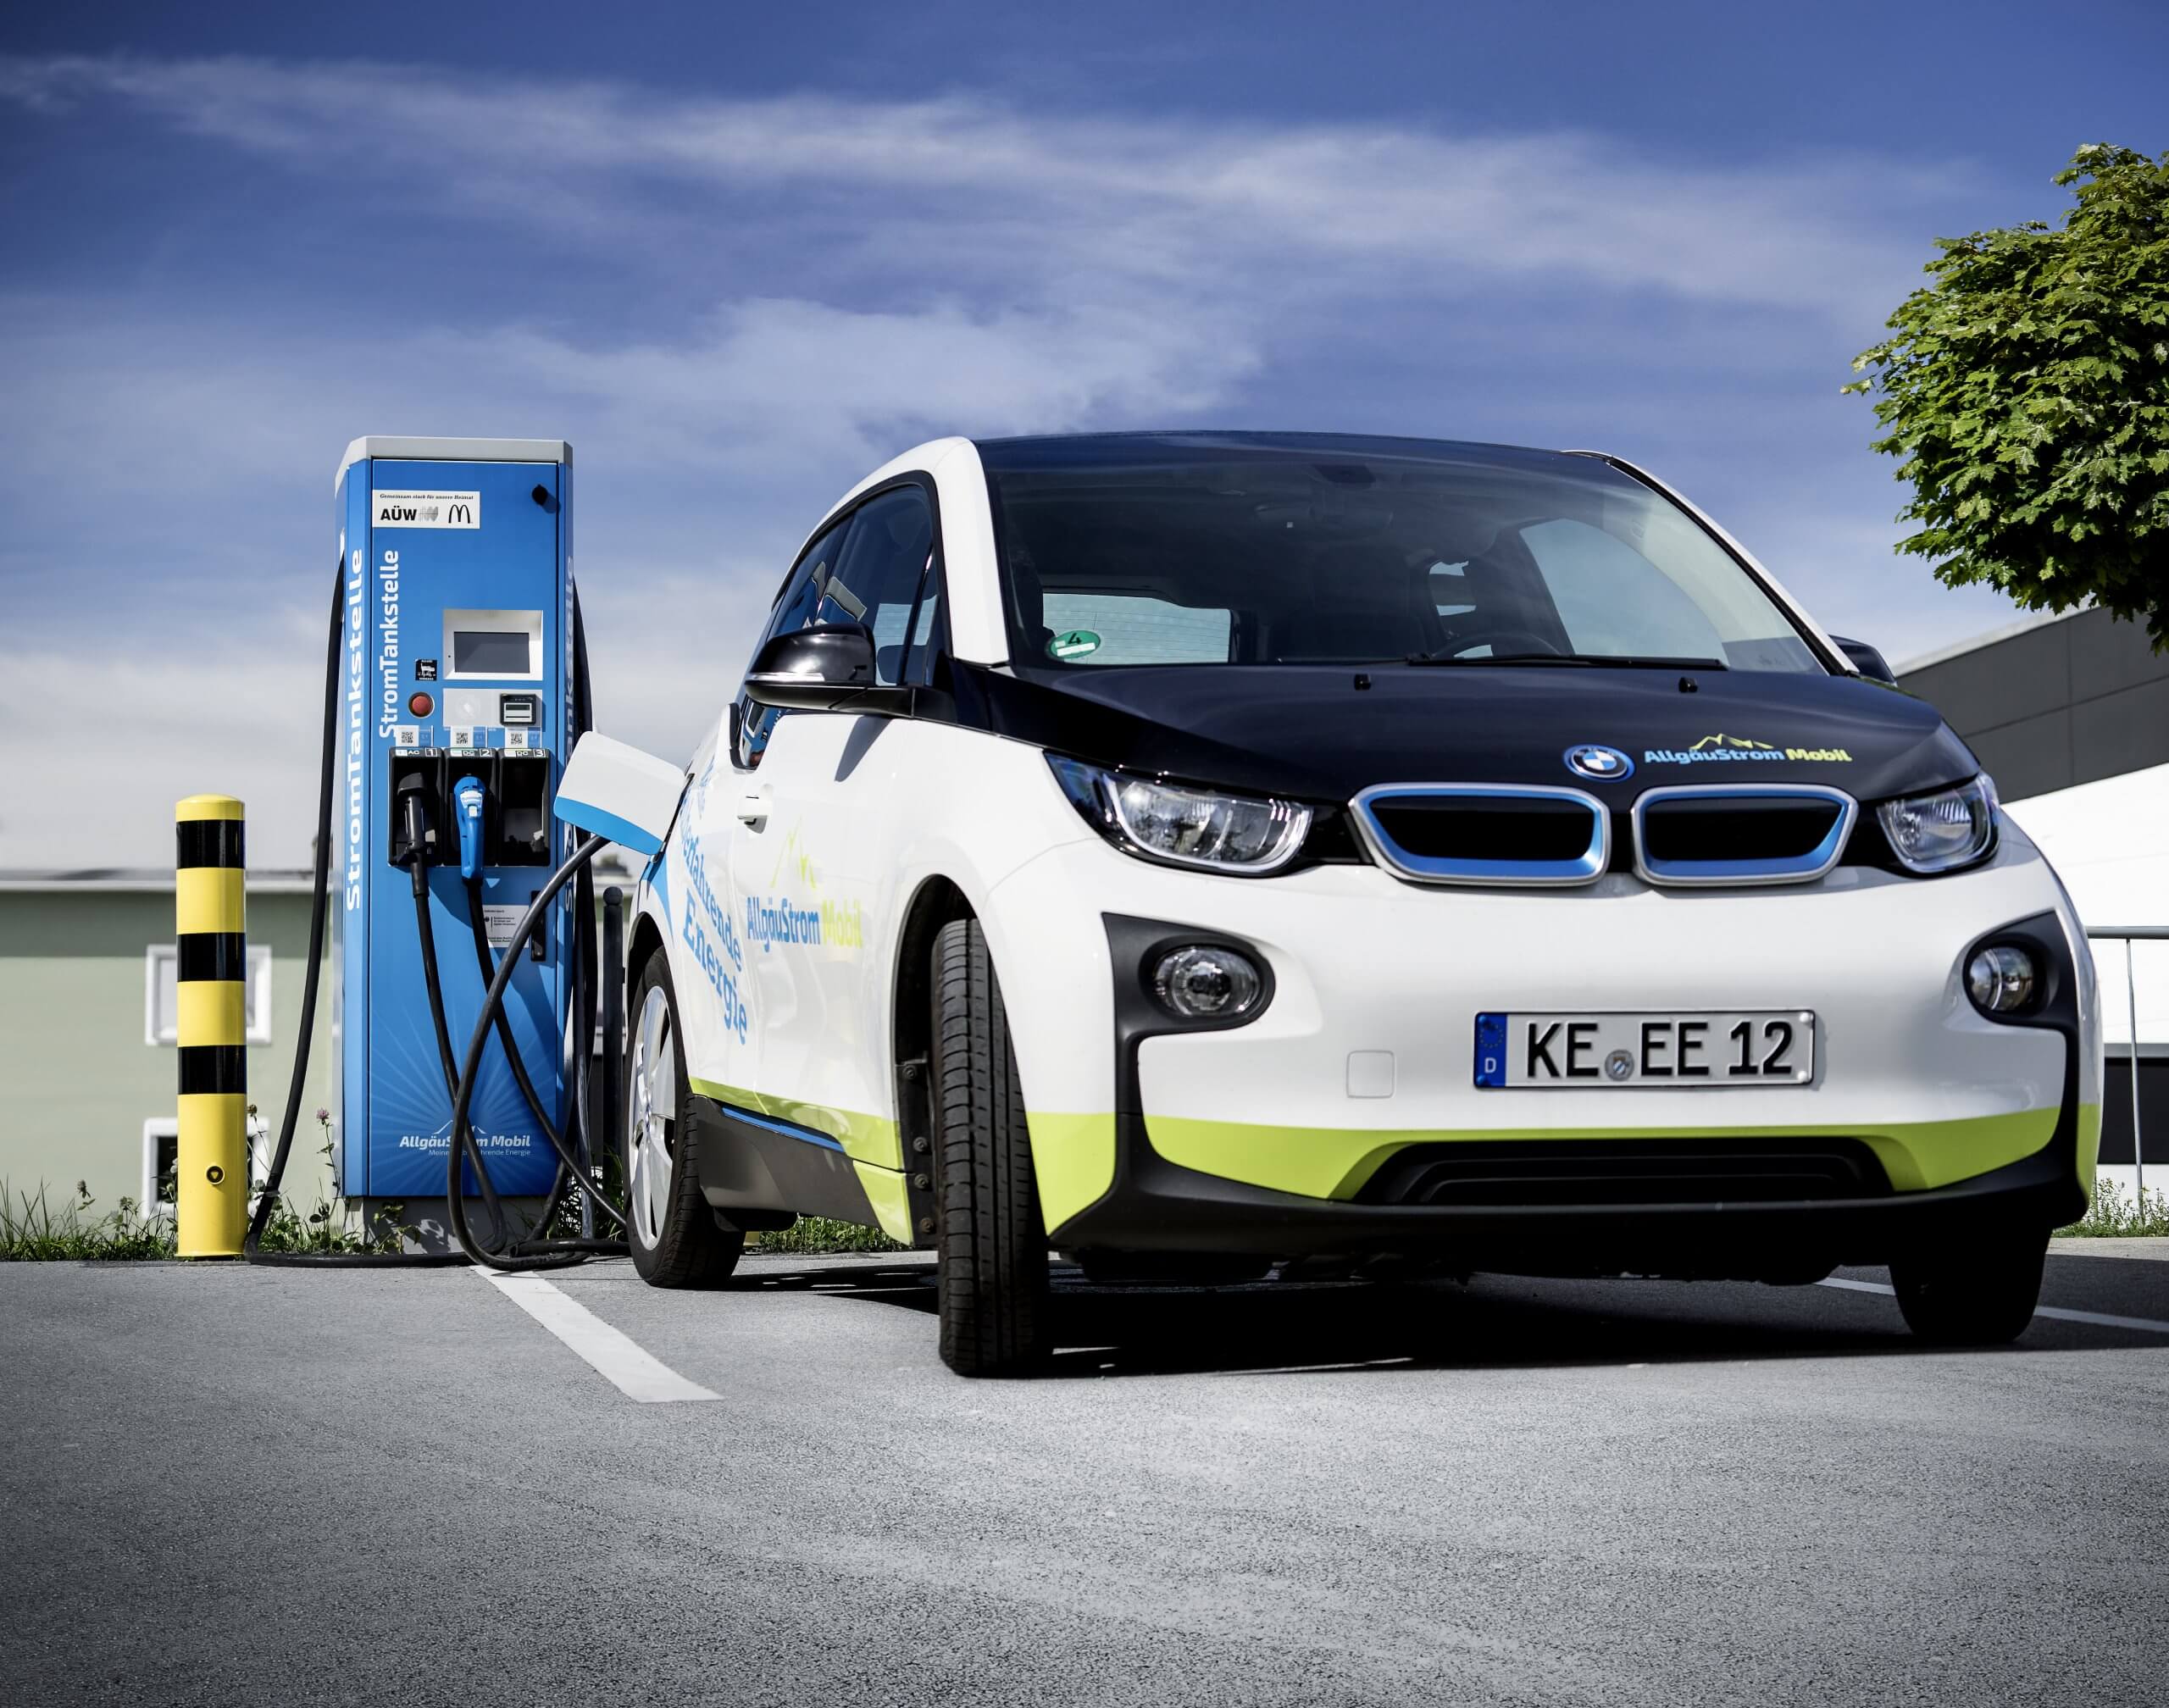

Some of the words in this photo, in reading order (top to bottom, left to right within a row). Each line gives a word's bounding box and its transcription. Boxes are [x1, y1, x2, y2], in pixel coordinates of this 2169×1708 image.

[380, 505, 418, 521] AÜW
[379, 550, 399, 739] StromTankstelle
[1068, 632, 1082, 645] 4
[347, 549, 363, 912] StromTankstelle
[1785, 747, 1853, 762] Mobil
[746, 896, 821, 953] AllgäuStrom
[821, 899, 863, 949] Mobil
[682, 888, 747, 1045] Energie
[1484, 1057, 1497, 1074] D
[1527, 1021, 1600, 1079] KE
[1640, 1021, 1710, 1077] EE
[1728, 1020, 1793, 1076] 12
[399, 1135, 489, 1151] AllgäuSm
[491, 1135, 530, 1147] Mobil
